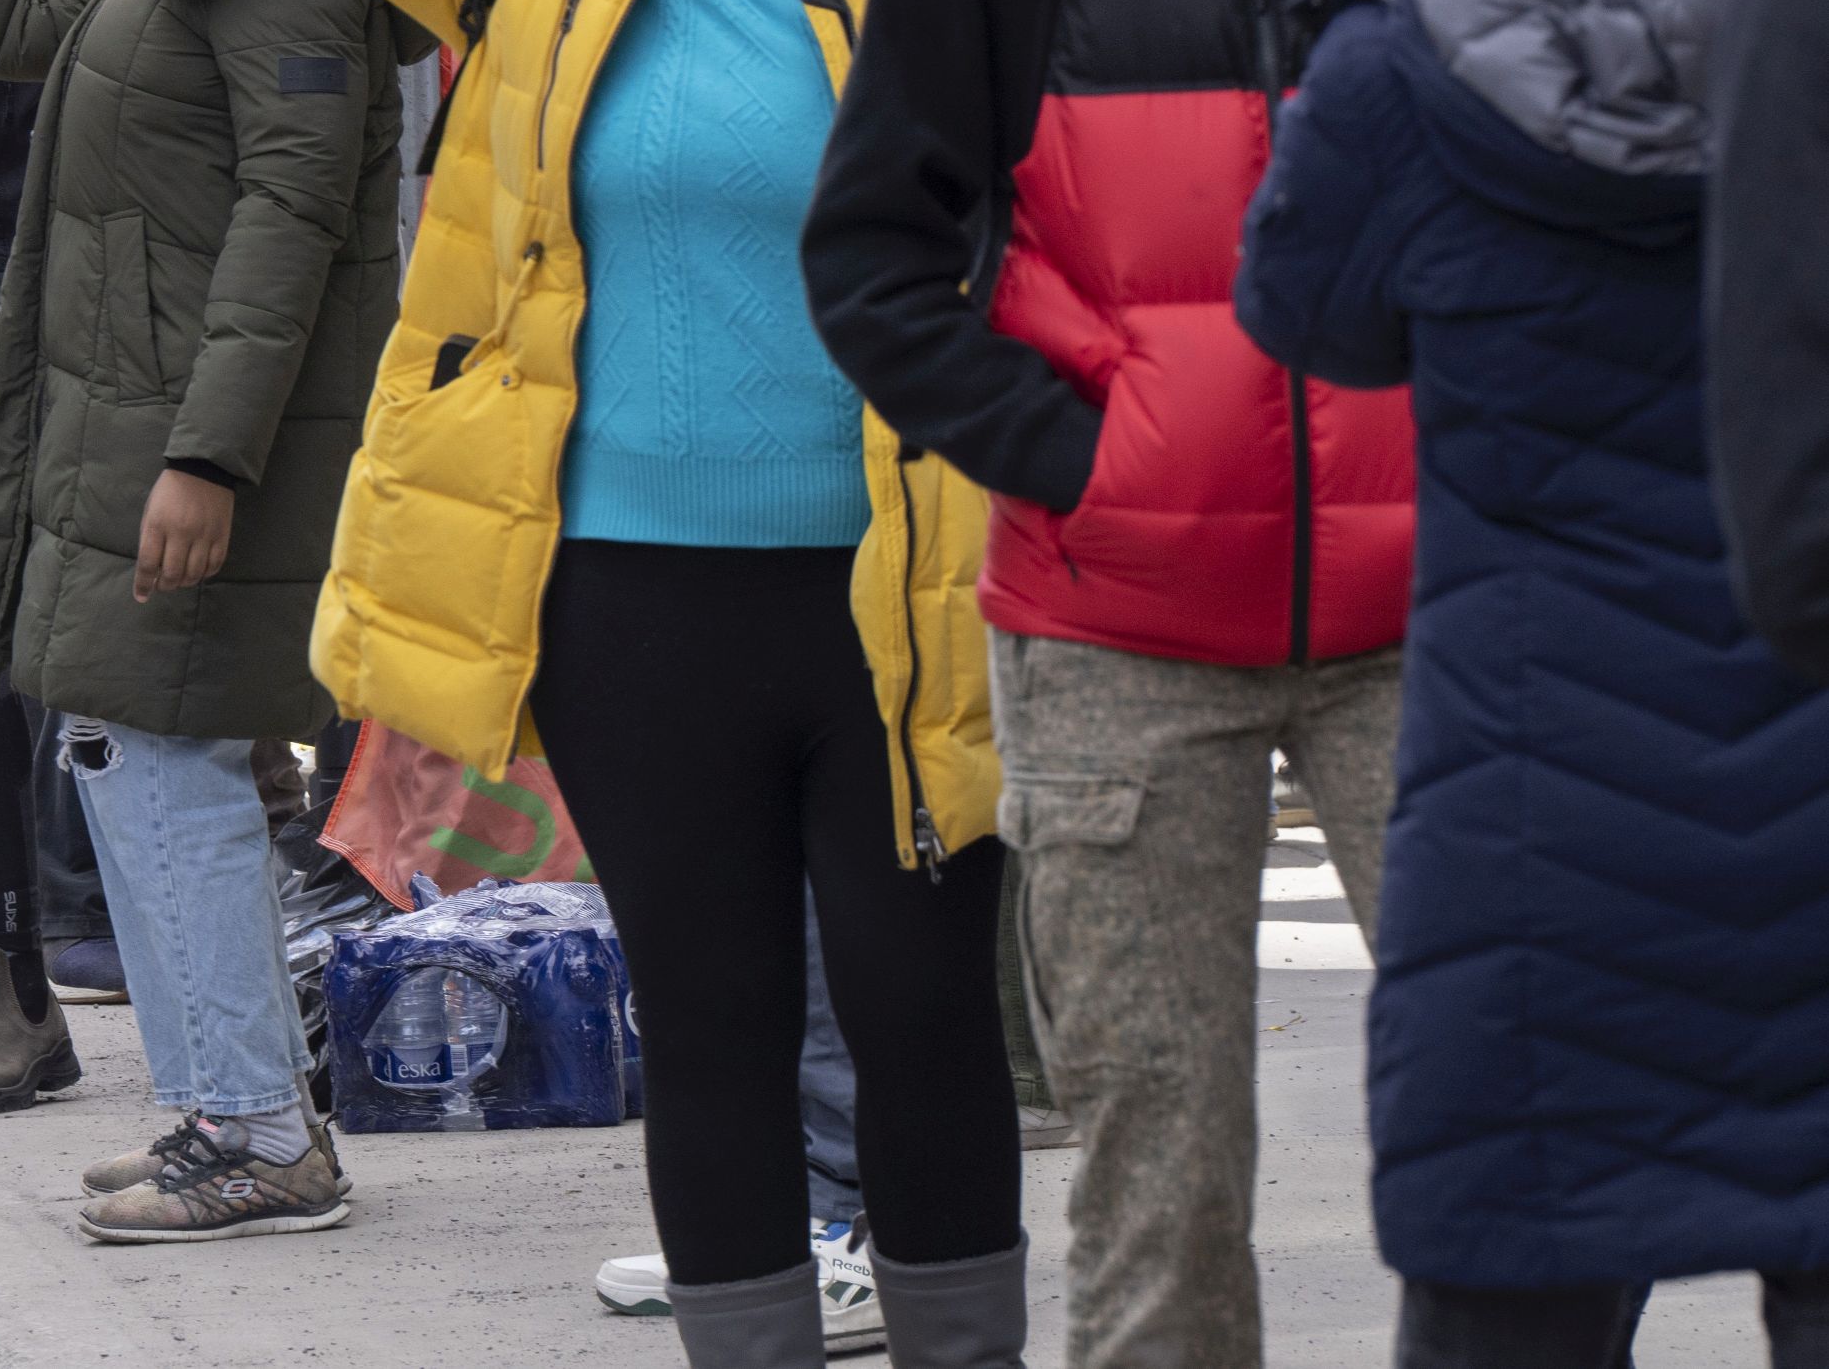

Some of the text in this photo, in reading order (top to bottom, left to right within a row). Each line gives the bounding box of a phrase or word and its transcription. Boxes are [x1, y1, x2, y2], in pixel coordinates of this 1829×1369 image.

[3, 890, 18, 933] SKINS
[397, 1059, 442, 1080] eska
[832, 1257, 872, 1277] Reeb
